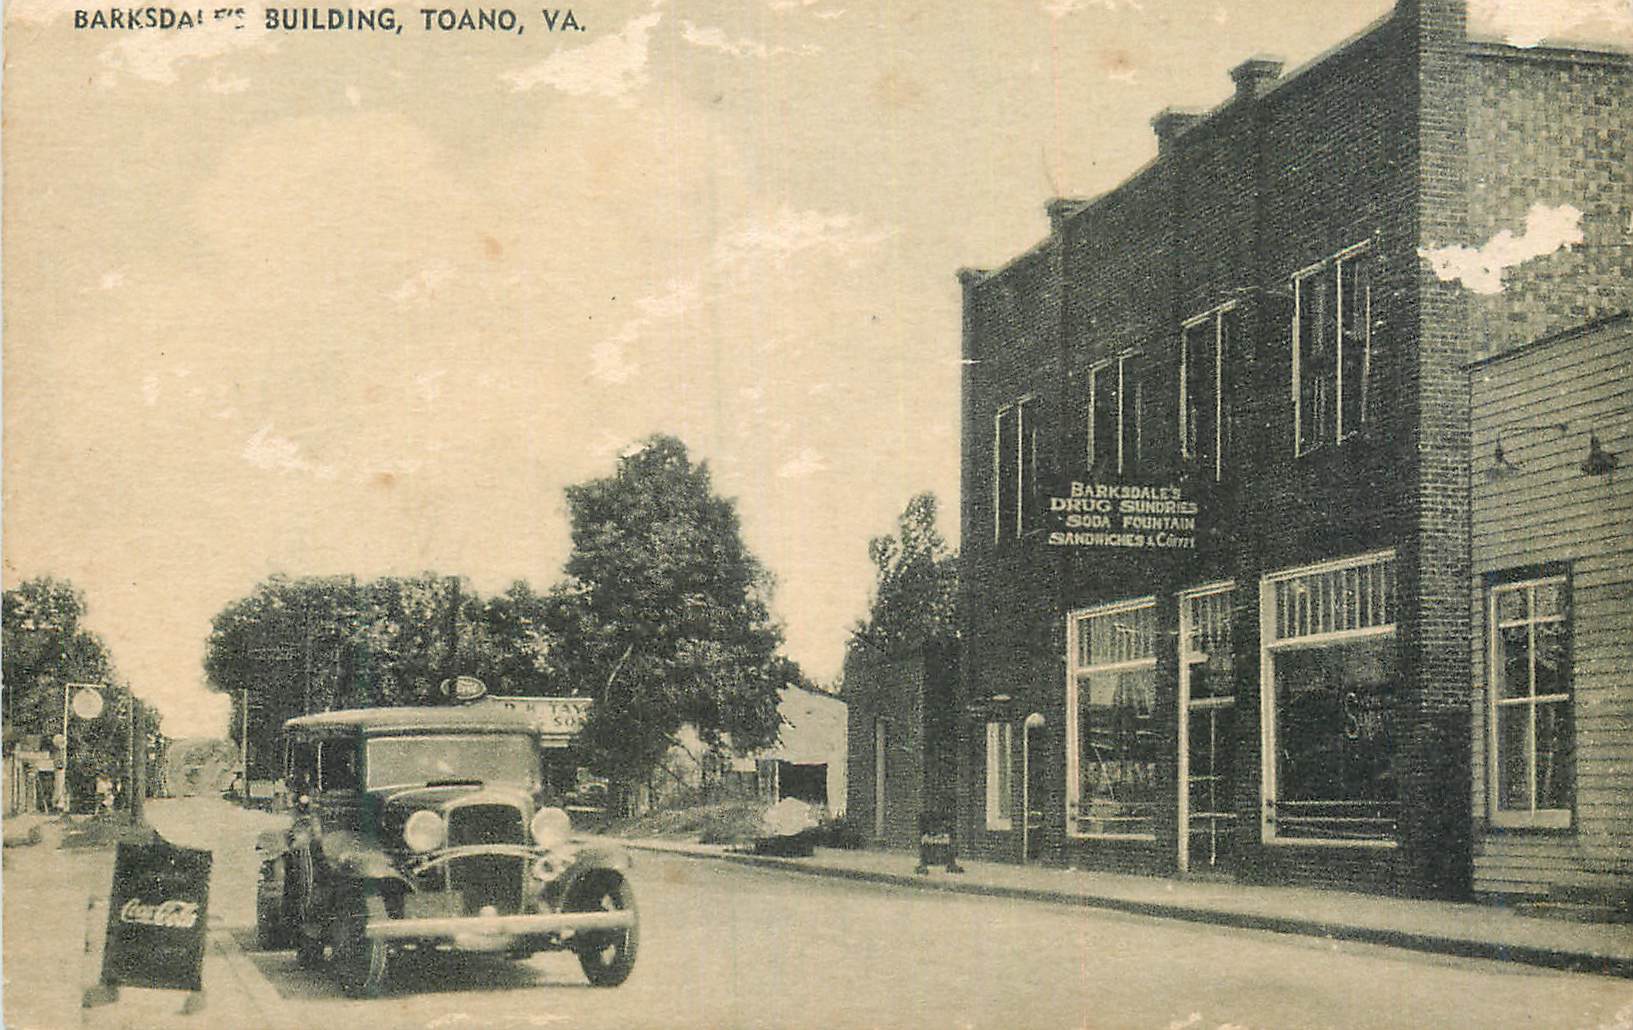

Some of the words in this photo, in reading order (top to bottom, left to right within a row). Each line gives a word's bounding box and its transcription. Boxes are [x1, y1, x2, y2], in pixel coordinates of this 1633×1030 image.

[1070, 481, 1182, 500] BARKSDALE'S
[1050, 497, 1113, 513] DRUG
[1119, 499, 1199, 514] SUNDRIES
[1065, 513, 1112, 529] SODA
[1123, 515, 1196, 531] FOUNTAIN
[1048, 531, 1145, 547] SANDWICHES
